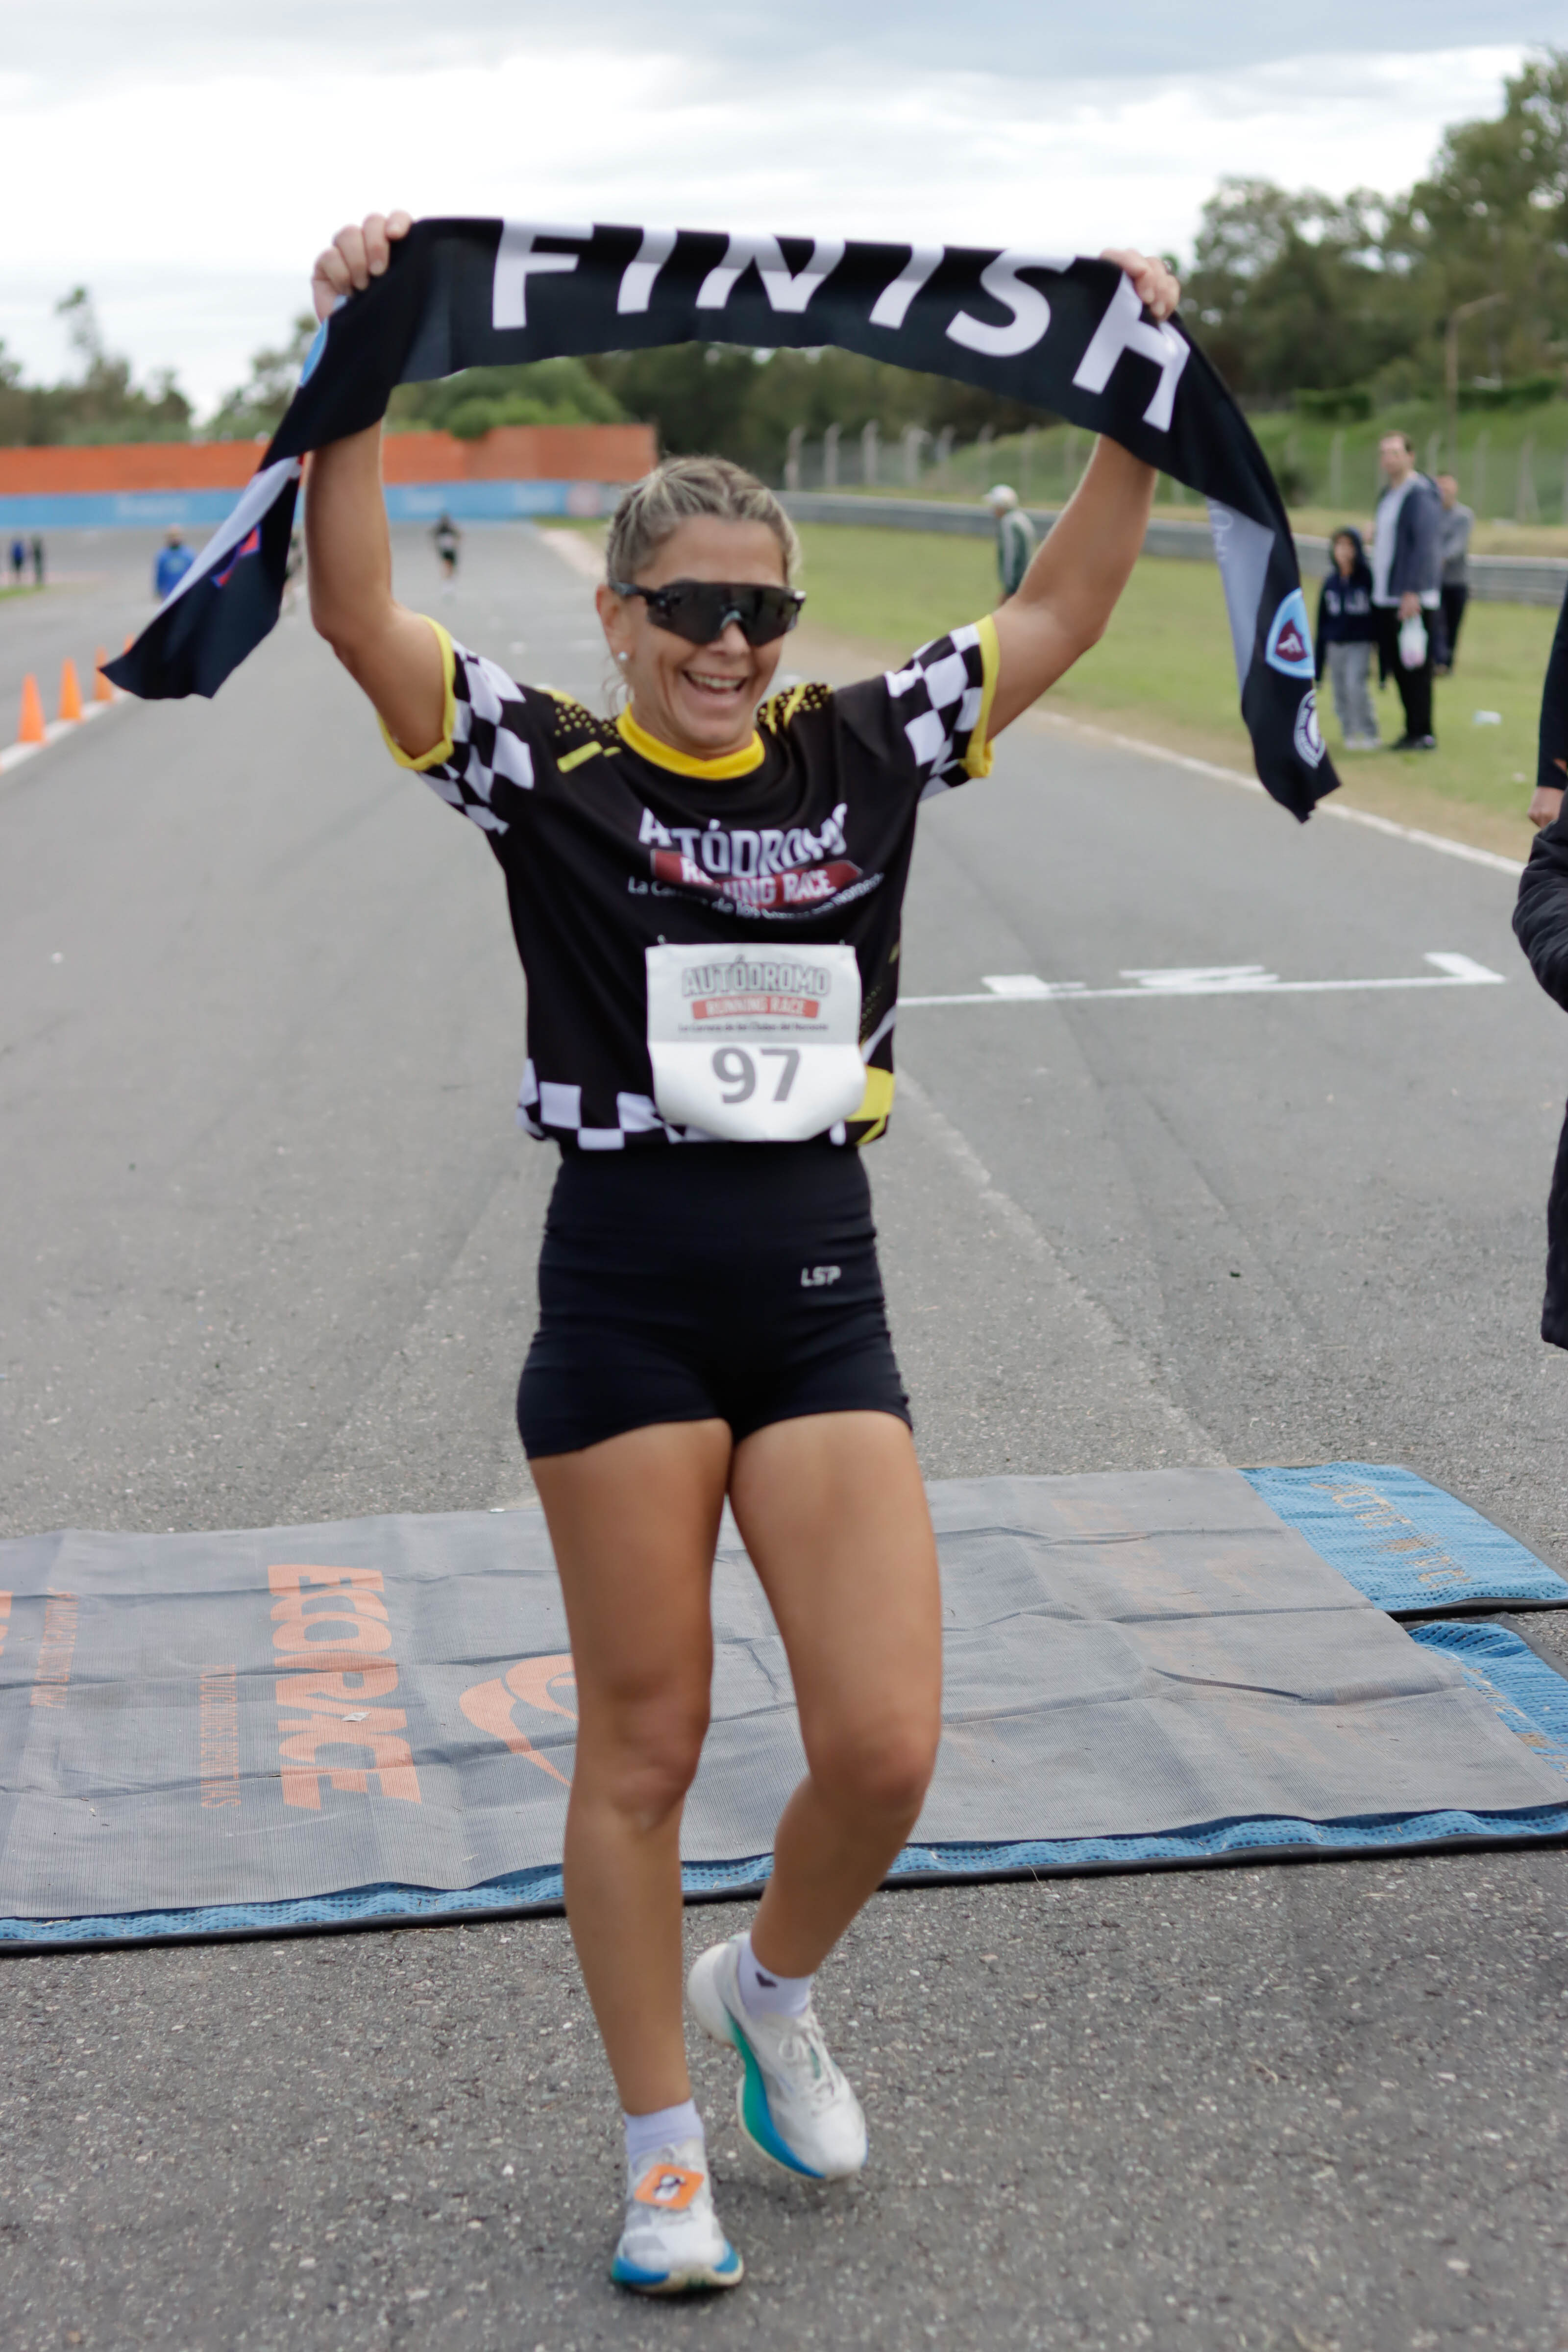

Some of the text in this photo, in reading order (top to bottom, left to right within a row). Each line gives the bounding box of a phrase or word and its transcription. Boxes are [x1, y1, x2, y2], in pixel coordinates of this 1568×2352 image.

[492, 219, 1190, 432] FINISH
[638, 803, 848, 878] ATÓDROMO
[782, 868, 837, 902] RACE
[682, 954, 831, 997] AUTÓDROMO
[706, 997, 806, 1016] RUNNING RACE
[712, 1046, 801, 1104] 97
[268, 1564, 421, 1811] ECORACE
